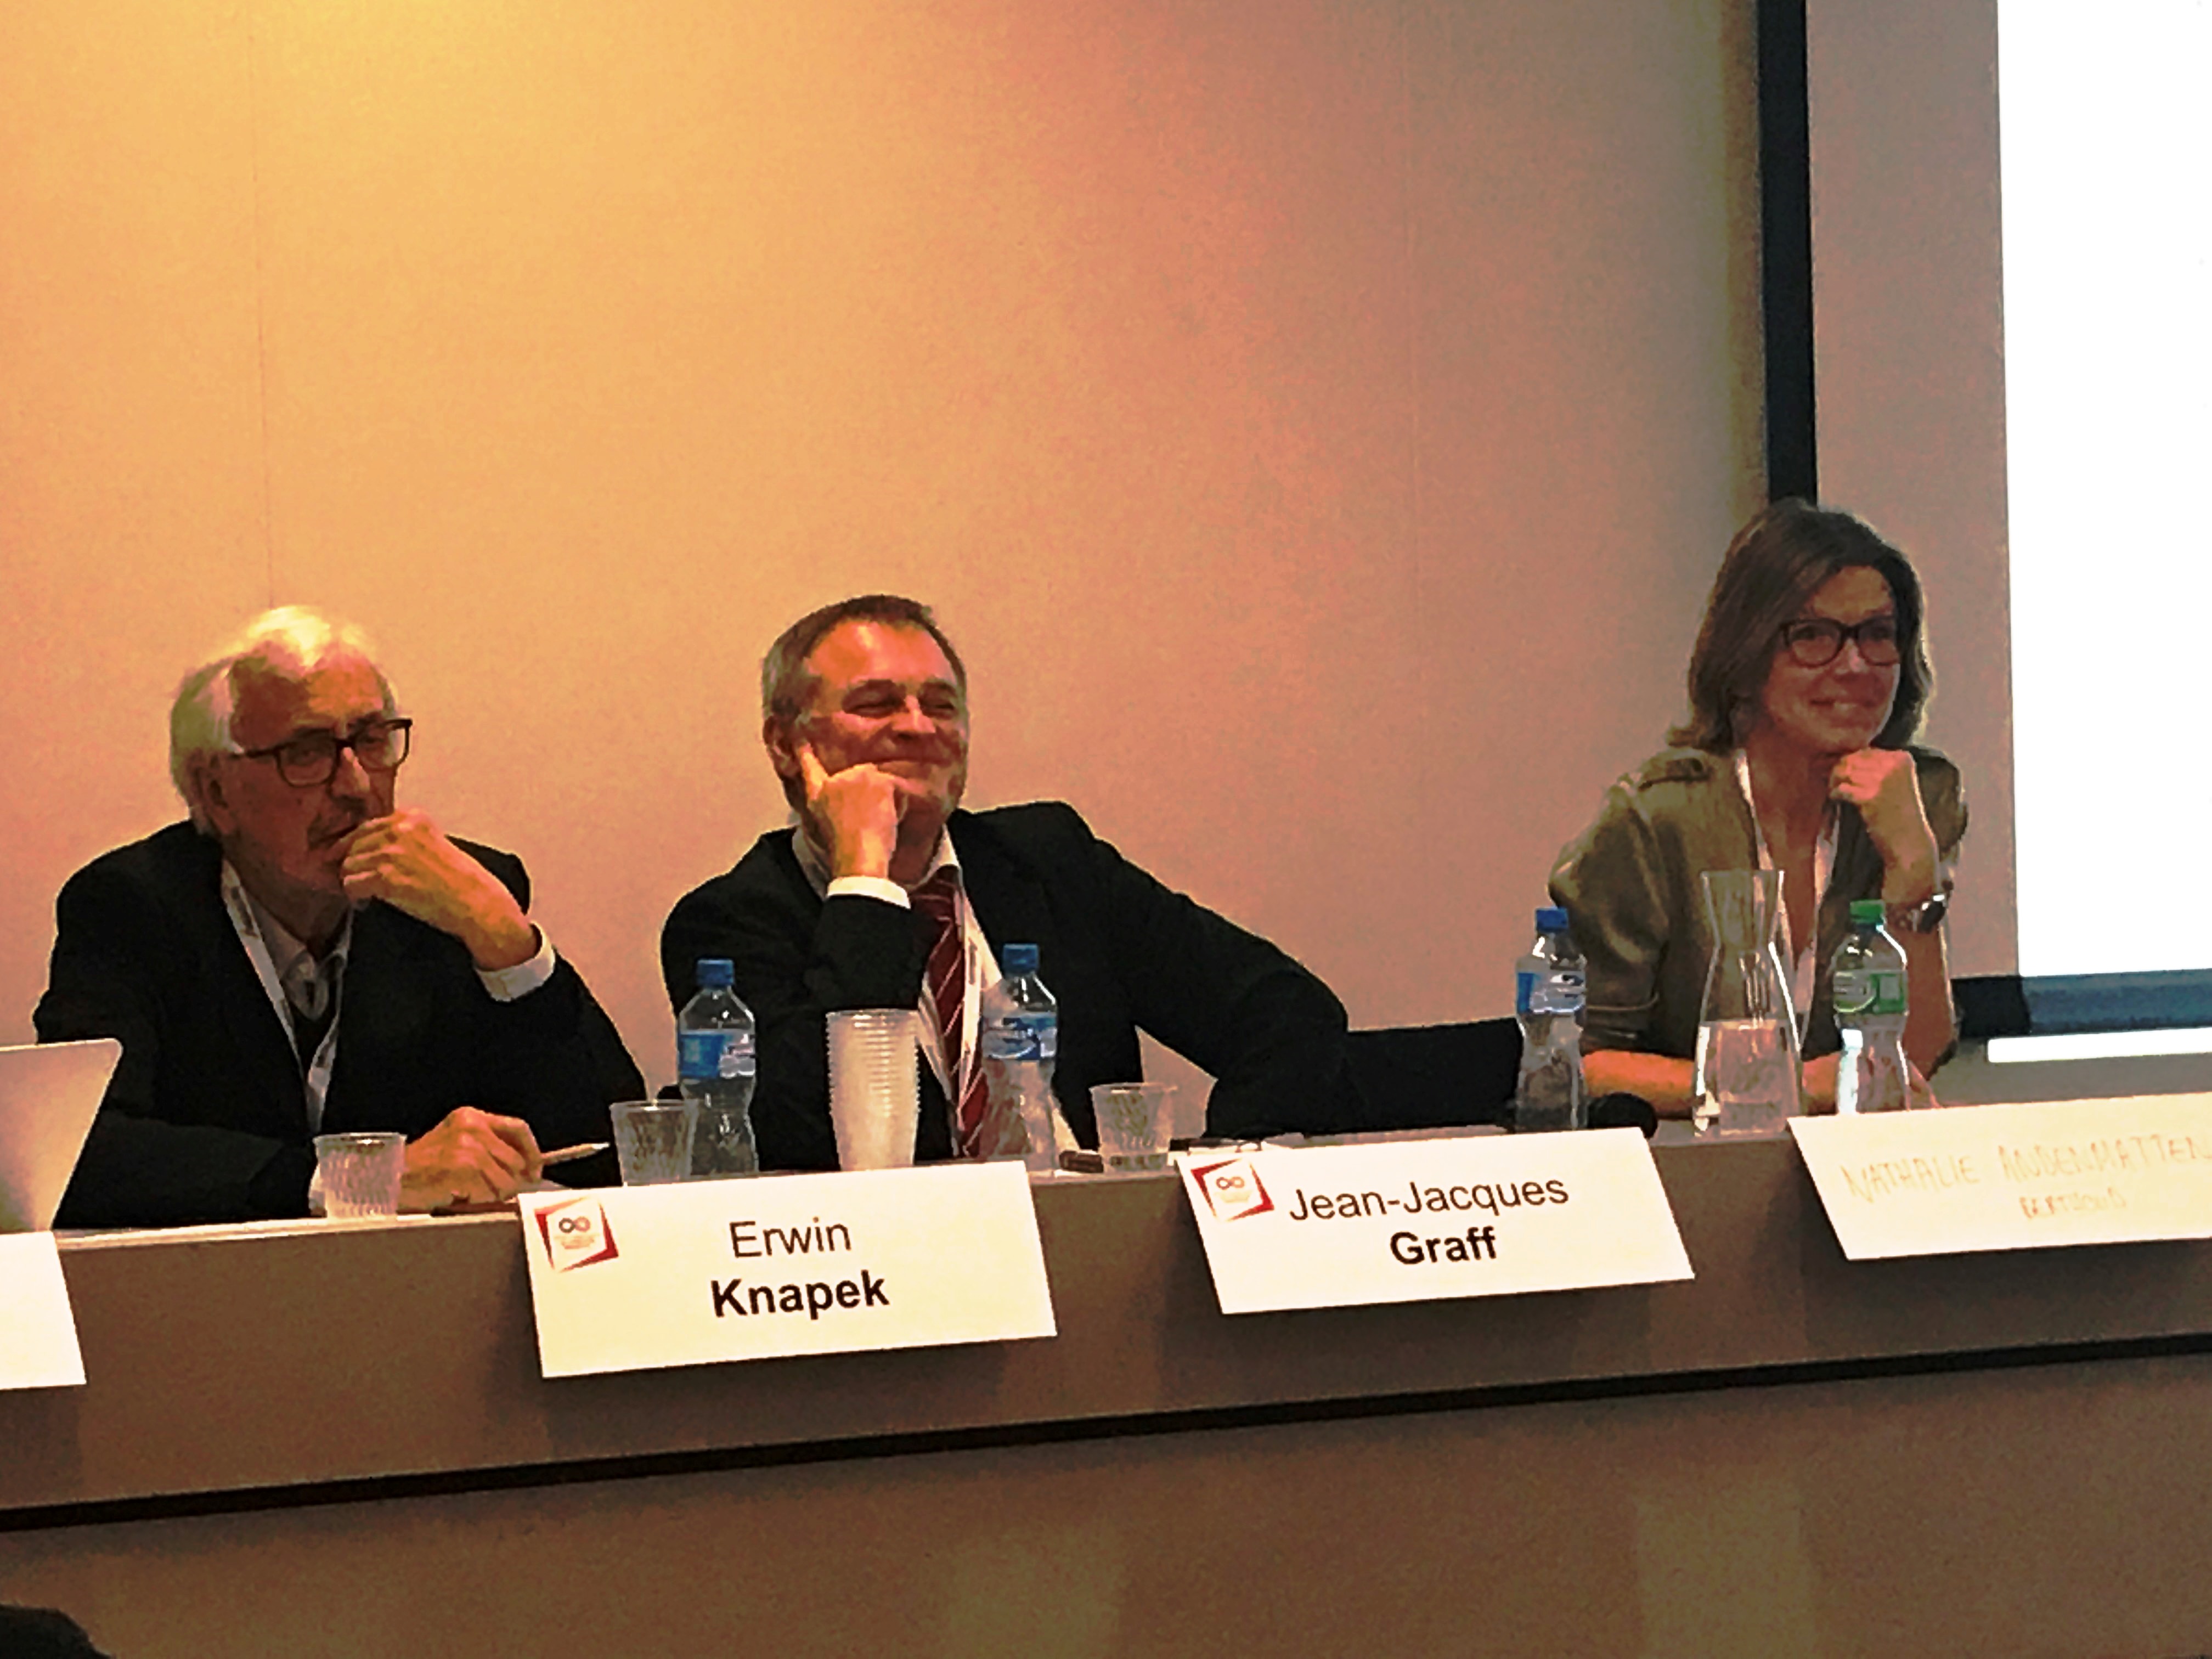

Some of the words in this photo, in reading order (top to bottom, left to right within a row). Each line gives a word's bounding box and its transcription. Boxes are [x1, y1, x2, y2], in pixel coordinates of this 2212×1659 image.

[1289, 1179, 1569, 1221] Jean-Jacques
[1840, 1154, 1980, 1204] NATHALIE
[729, 1217, 851, 1259] Erwin
[1390, 1226, 1497, 1265] Graff
[710, 1269, 890, 1321] Knapek
